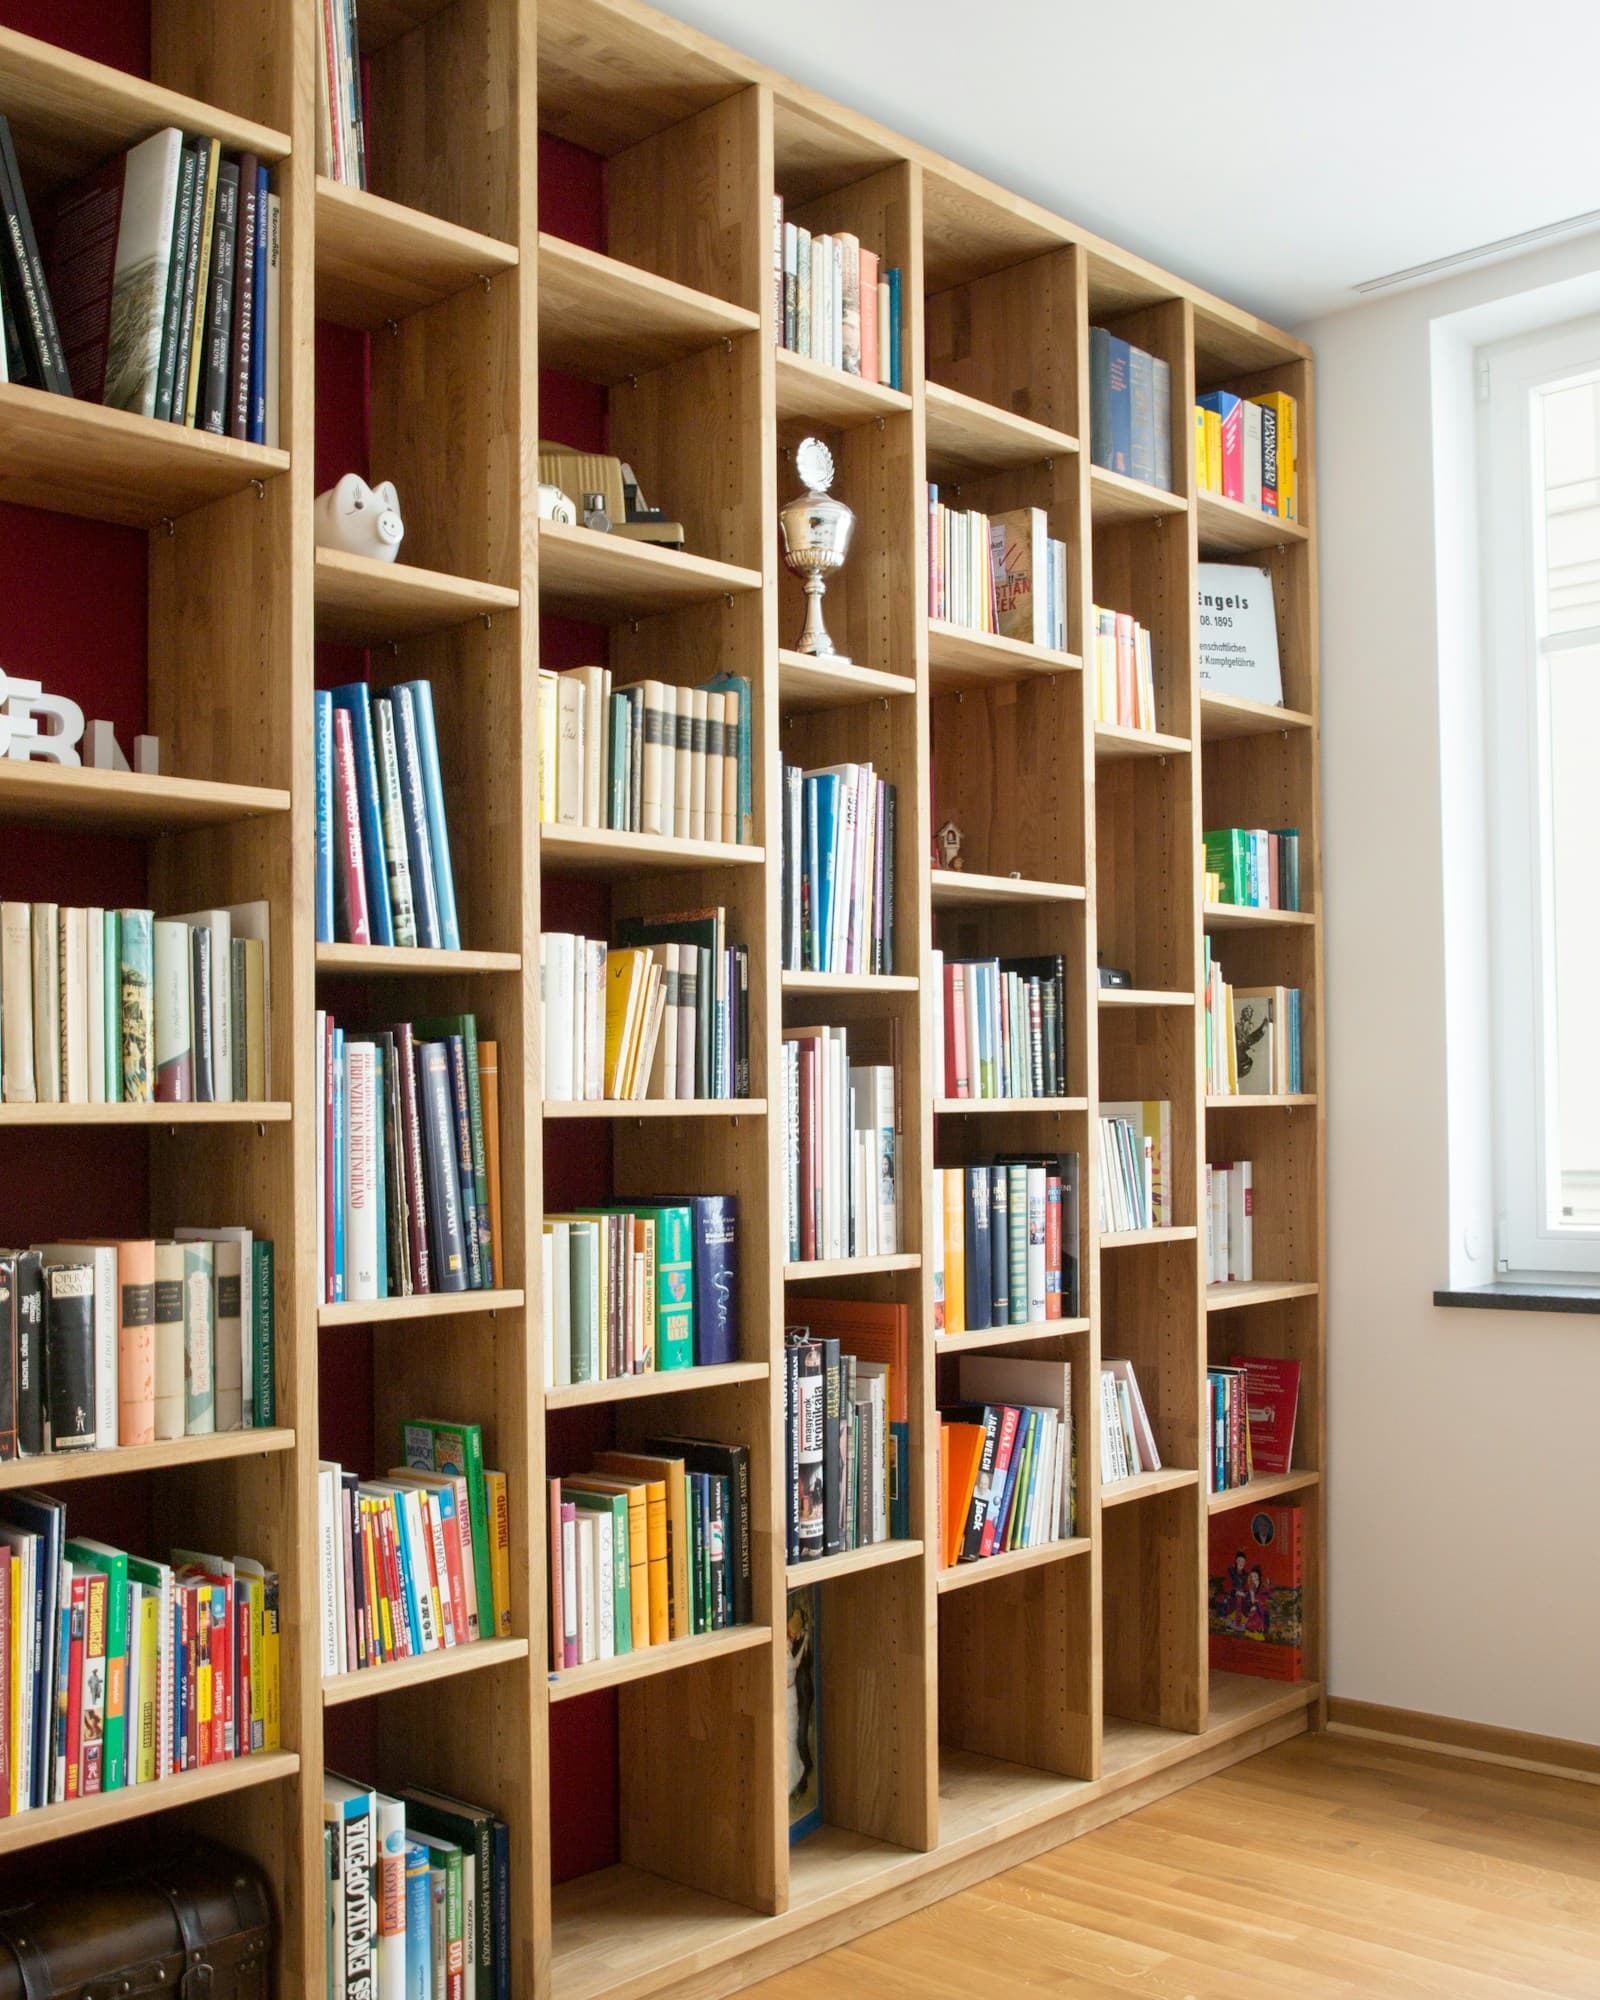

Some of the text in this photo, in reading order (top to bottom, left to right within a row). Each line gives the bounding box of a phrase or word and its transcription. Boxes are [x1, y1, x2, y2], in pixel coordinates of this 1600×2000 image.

[182, 157, 194, 194] UNGARN
[9, 214, 25, 257] SOPRON
[176, 209, 190, 260] SCHLÖSSER
[238, 192, 255, 423] PÉTER KORNISS HUNGARY
[996, 579, 1032, 600] STIAN
[1200, 642, 1247, 653] enschaftlichen
[1205, 655, 1256, 669] Kampfgefährte
[350, 1053, 364, 1209] FERIENZIELE IN DEUTSCHLAND
[437, 1087, 450, 1146] 2001/2002
[454, 1043, 472, 1171] DIERCKE WELTATLAS
[467, 1037, 486, 1177] Meyers Universalatlas
[446, 1202, 458, 1236] ADAC
[419, 1250, 428, 1287] Lingen
[467, 1206, 481, 1283] westermann
[259, 1255, 270, 1297] MONDÁK
[259, 1312, 270, 1343] REGÉK
[20, 1333, 29, 1390] LENGYEL DÉNES
[261, 1345, 270, 1374] KELTA
[791, 1355, 799, 1413] EURÓPÁBAN
[804, 1399, 813, 1443] magyarok
[810, 1386, 823, 1451] krónikája
[1000, 1411, 1016, 1451] GOAL
[981, 1414, 998, 1472] JACK WELCH
[458, 1499, 470, 1547] UNGARN
[497, 1495, 507, 1550] THAILAND
[973, 1499, 987, 1531] jack
[433, 1523, 447, 1576] SLOWAKEI
[252, 1587, 260, 1621] Schweiz
[325, 1526, 335, 1666] UTAZÁSOK SPANYOLORSZÁGBAN
[395, 1550, 410, 1623] COSTA BLANCA
[420, 1595, 432, 1641] ROMA
[252, 1623, 261, 1668] Sächsische
[214, 1671, 224, 1714] Stuttgart
[344, 1815, 371, 1977] ENCIKLOPÉDIA
[384, 1862, 397, 1932] LEXIKON
[480, 1830, 491, 1967] KÖZGAZDASÁGI KISLEXIKON
[449, 1940, 463, 1974] 100
